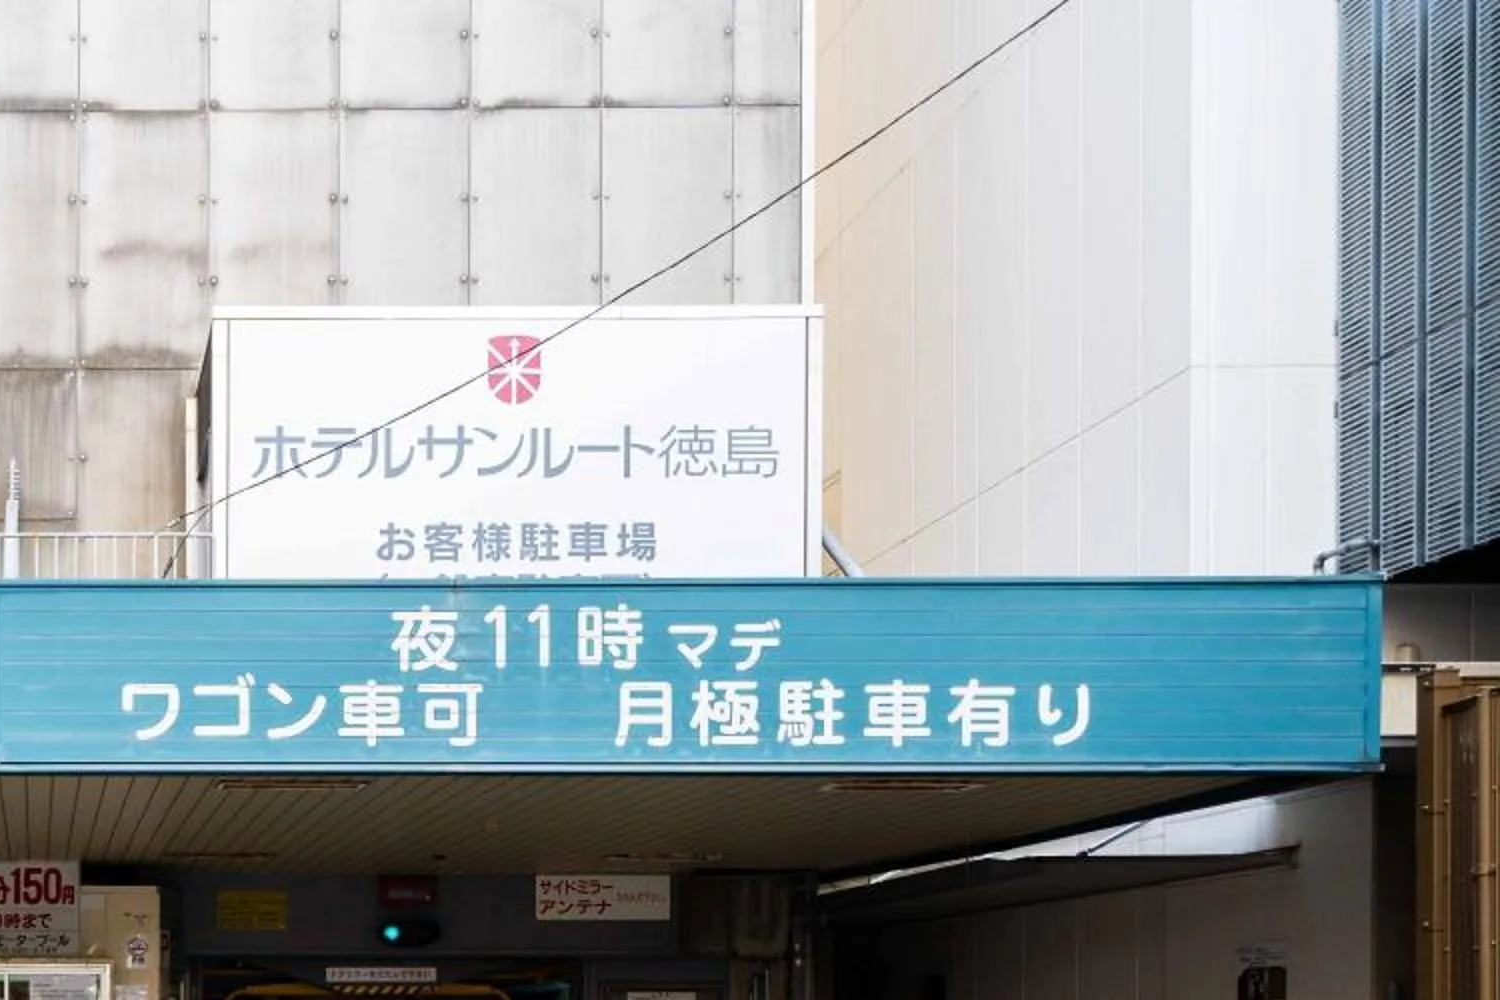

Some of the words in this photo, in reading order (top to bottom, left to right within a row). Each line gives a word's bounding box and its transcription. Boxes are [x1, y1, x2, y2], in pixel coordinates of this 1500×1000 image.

[251, 424, 780, 479] ホテルサンルート徳島
[376, 522, 657, 562] お客様駐車場
[120, 675, 485, 748] ワゴン車可
[614, 680, 1090, 748] 月極駐車有り
[539, 879, 613, 895] サイドミラー
[539, 900, 612, 915] アンテナ
